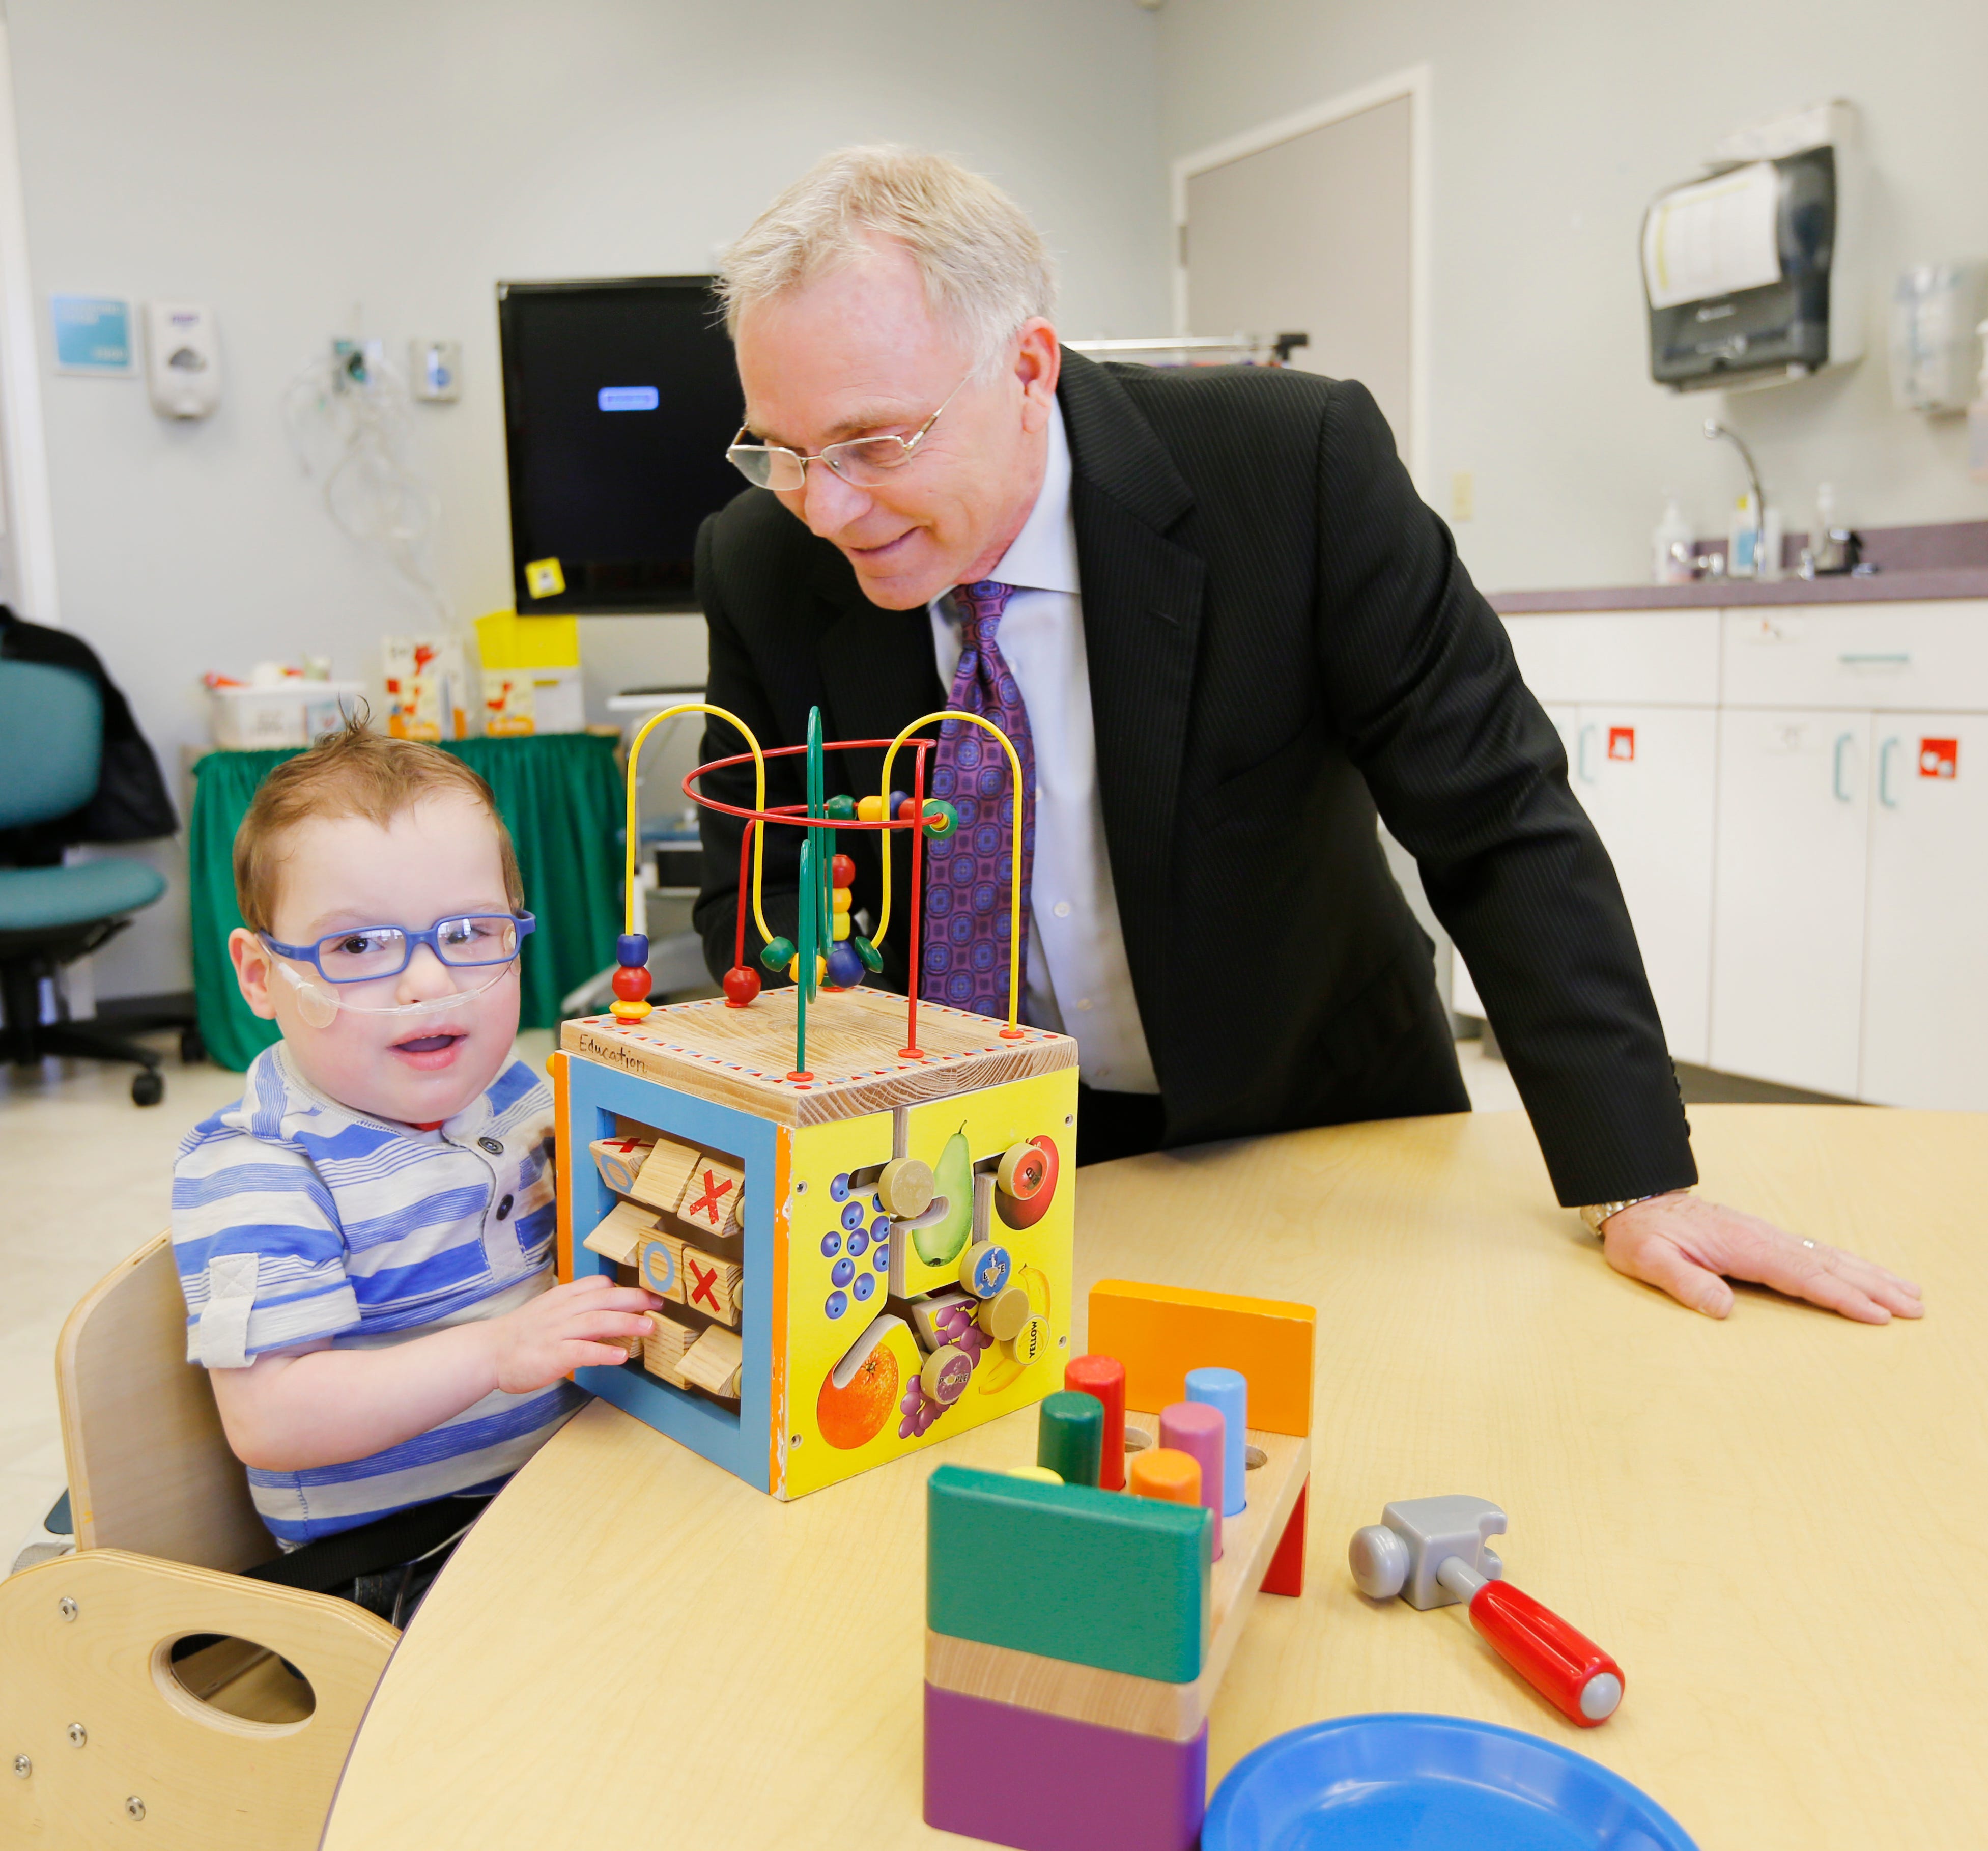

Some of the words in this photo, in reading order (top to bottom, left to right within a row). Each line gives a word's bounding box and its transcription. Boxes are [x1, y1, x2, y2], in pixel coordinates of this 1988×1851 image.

[579, 1034, 647, 1073] Education
[983, 1264, 1005, 1279] BE
[1029, 1321, 1038, 1358] YELLOW
[939, 1374, 968, 1385] PPLE
